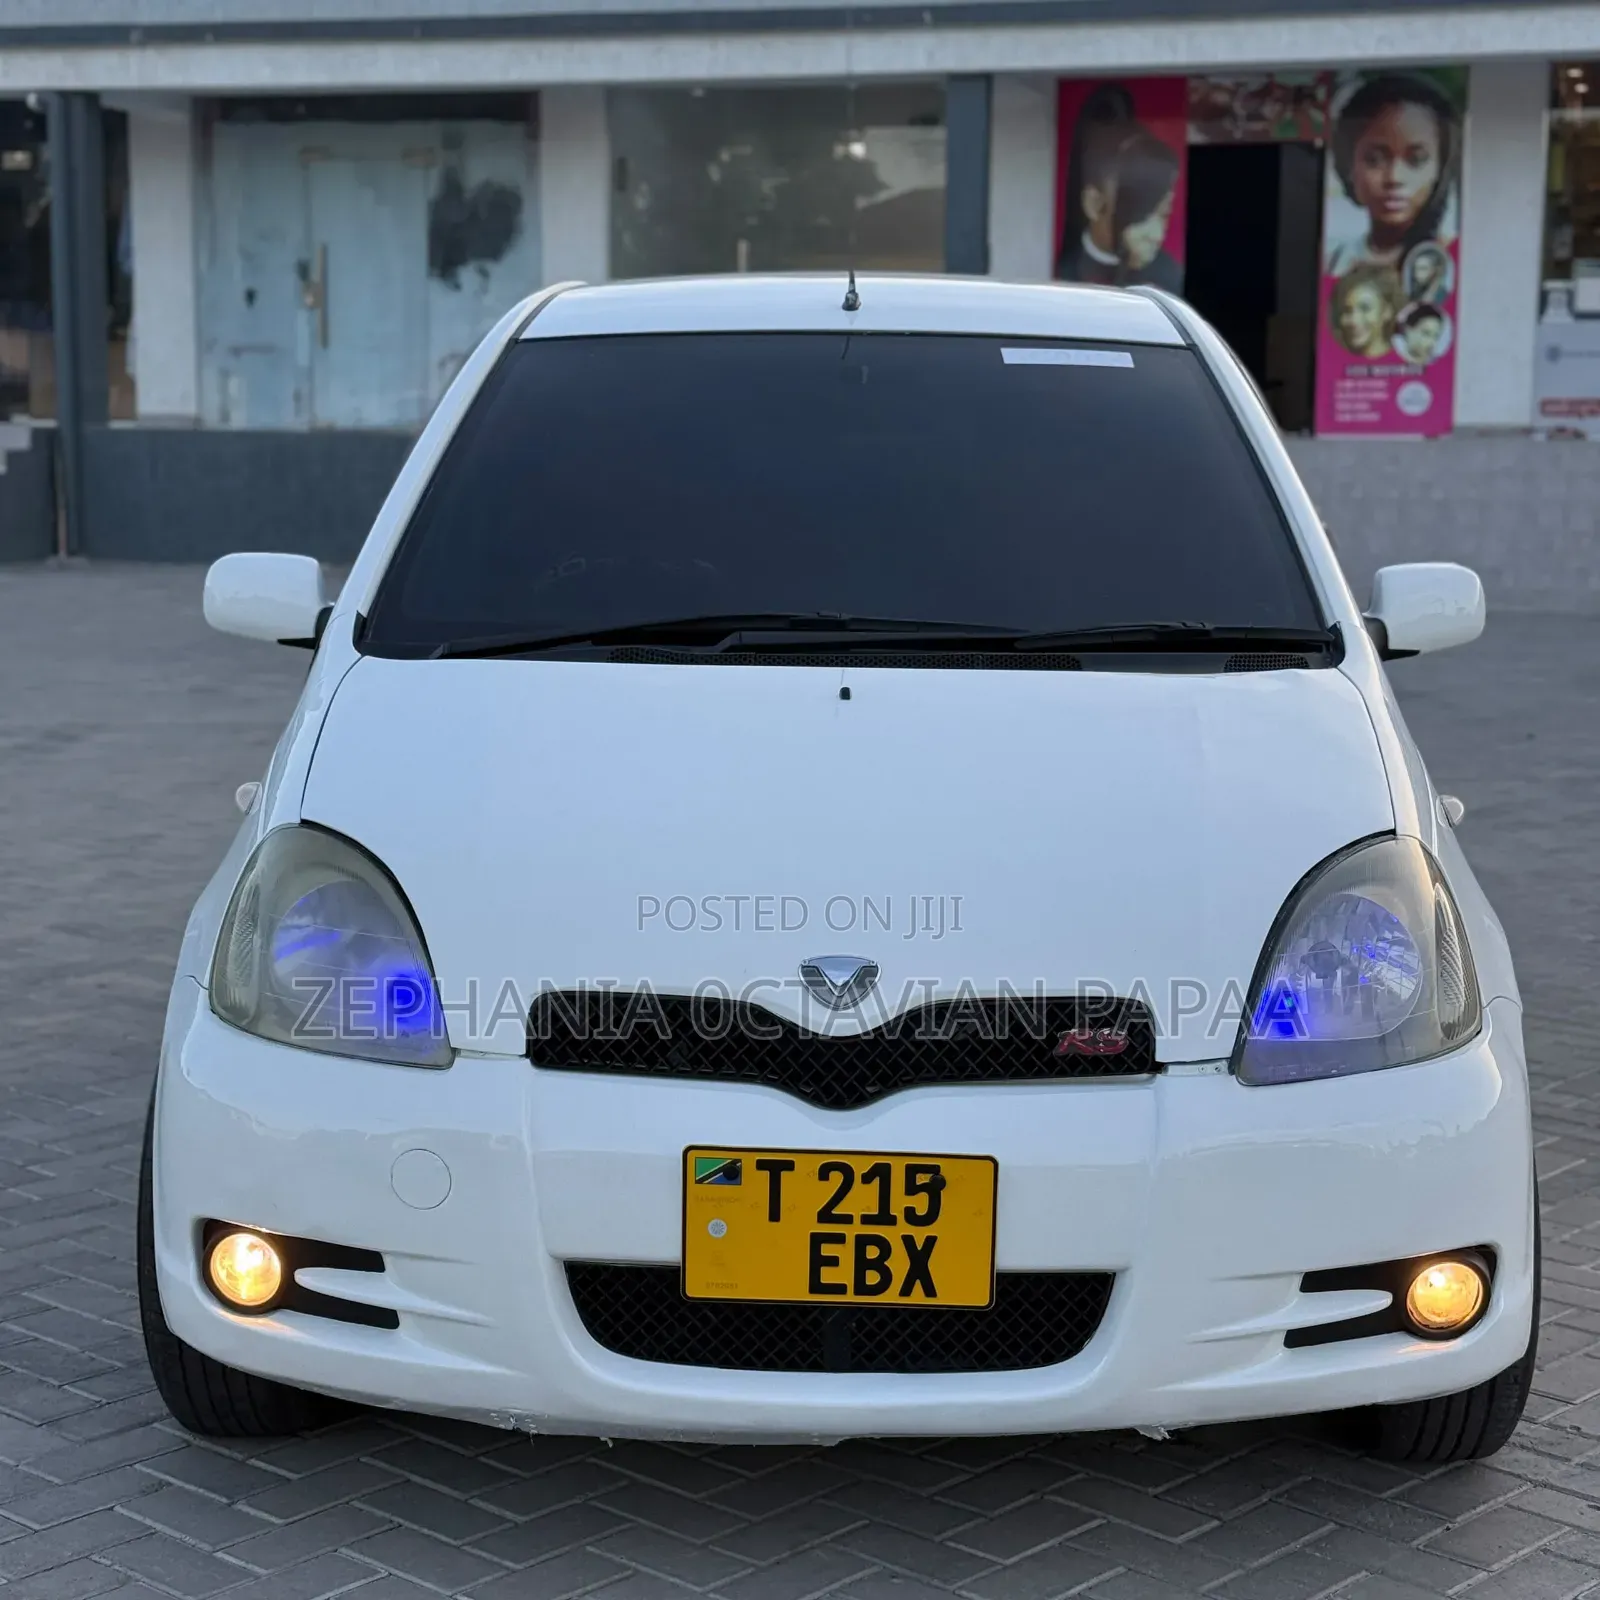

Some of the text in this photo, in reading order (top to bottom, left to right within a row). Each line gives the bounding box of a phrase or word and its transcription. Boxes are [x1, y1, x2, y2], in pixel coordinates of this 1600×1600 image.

[755, 1158, 947, 1227] T 215
[808, 1231, 939, 1298] EBX
